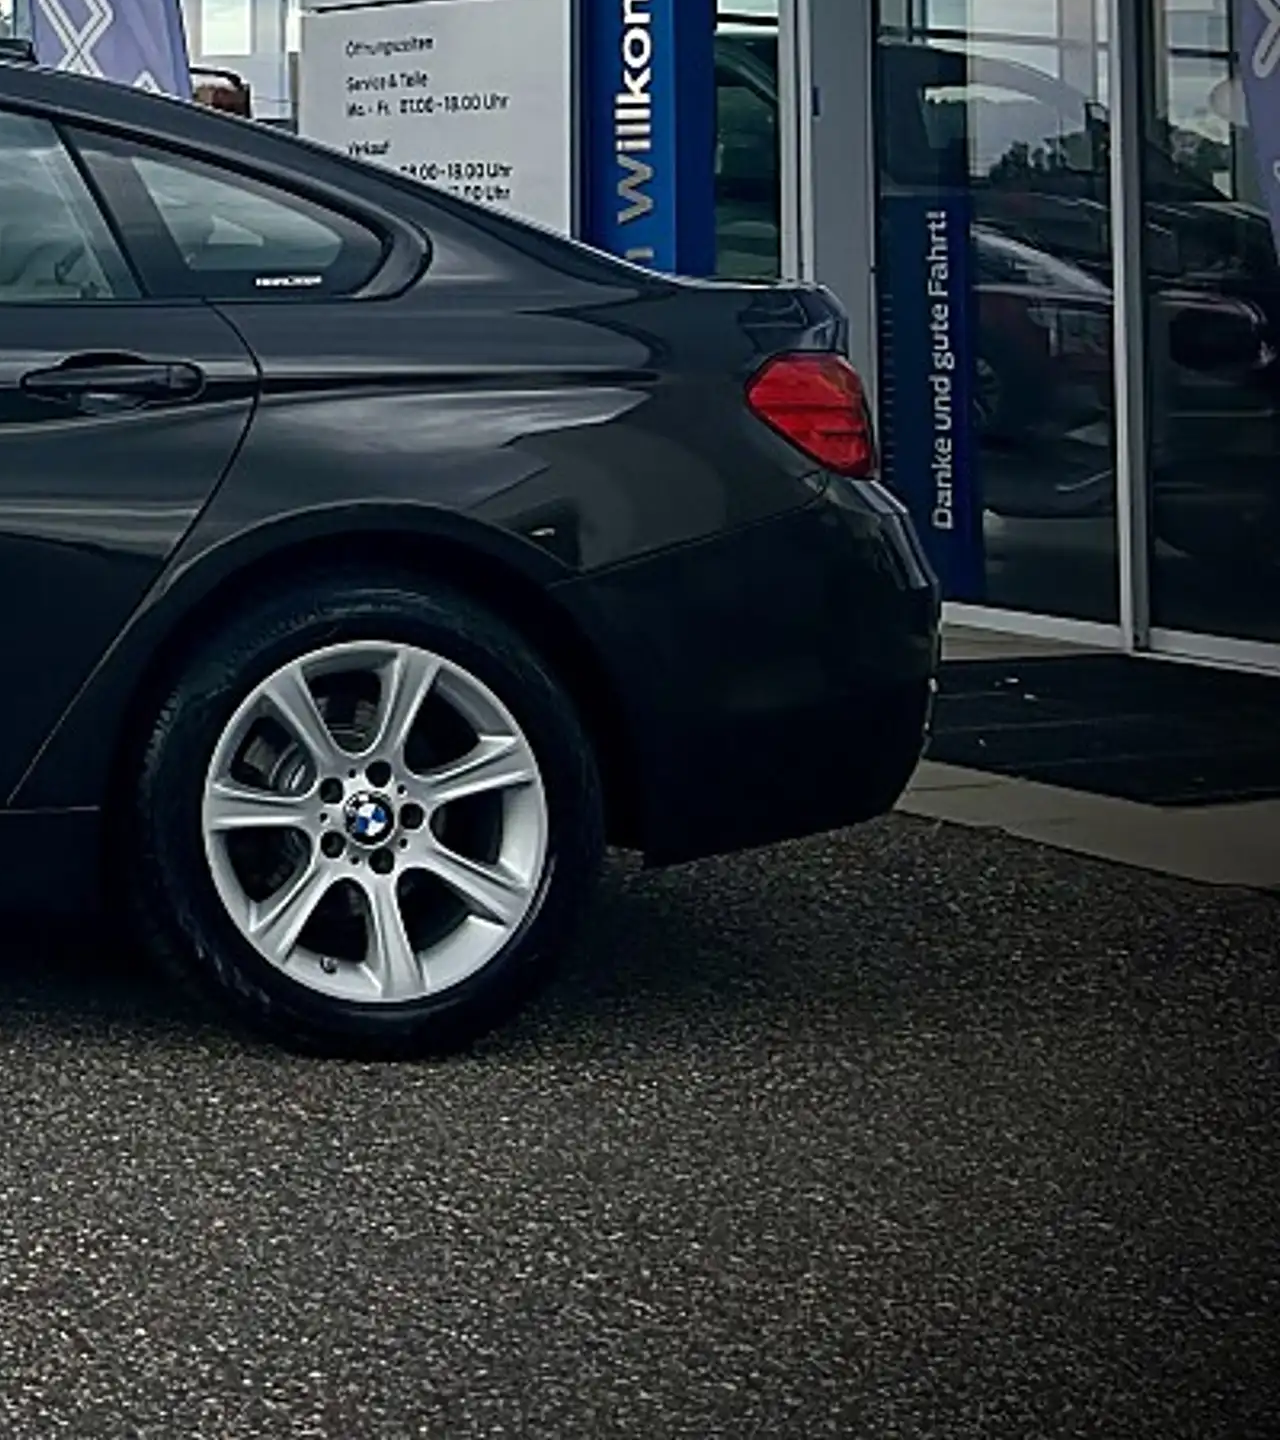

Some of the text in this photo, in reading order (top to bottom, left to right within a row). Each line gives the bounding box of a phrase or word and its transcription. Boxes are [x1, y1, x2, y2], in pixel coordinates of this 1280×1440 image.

[925, 210, 956, 530] Danke und gute Fahrt!
